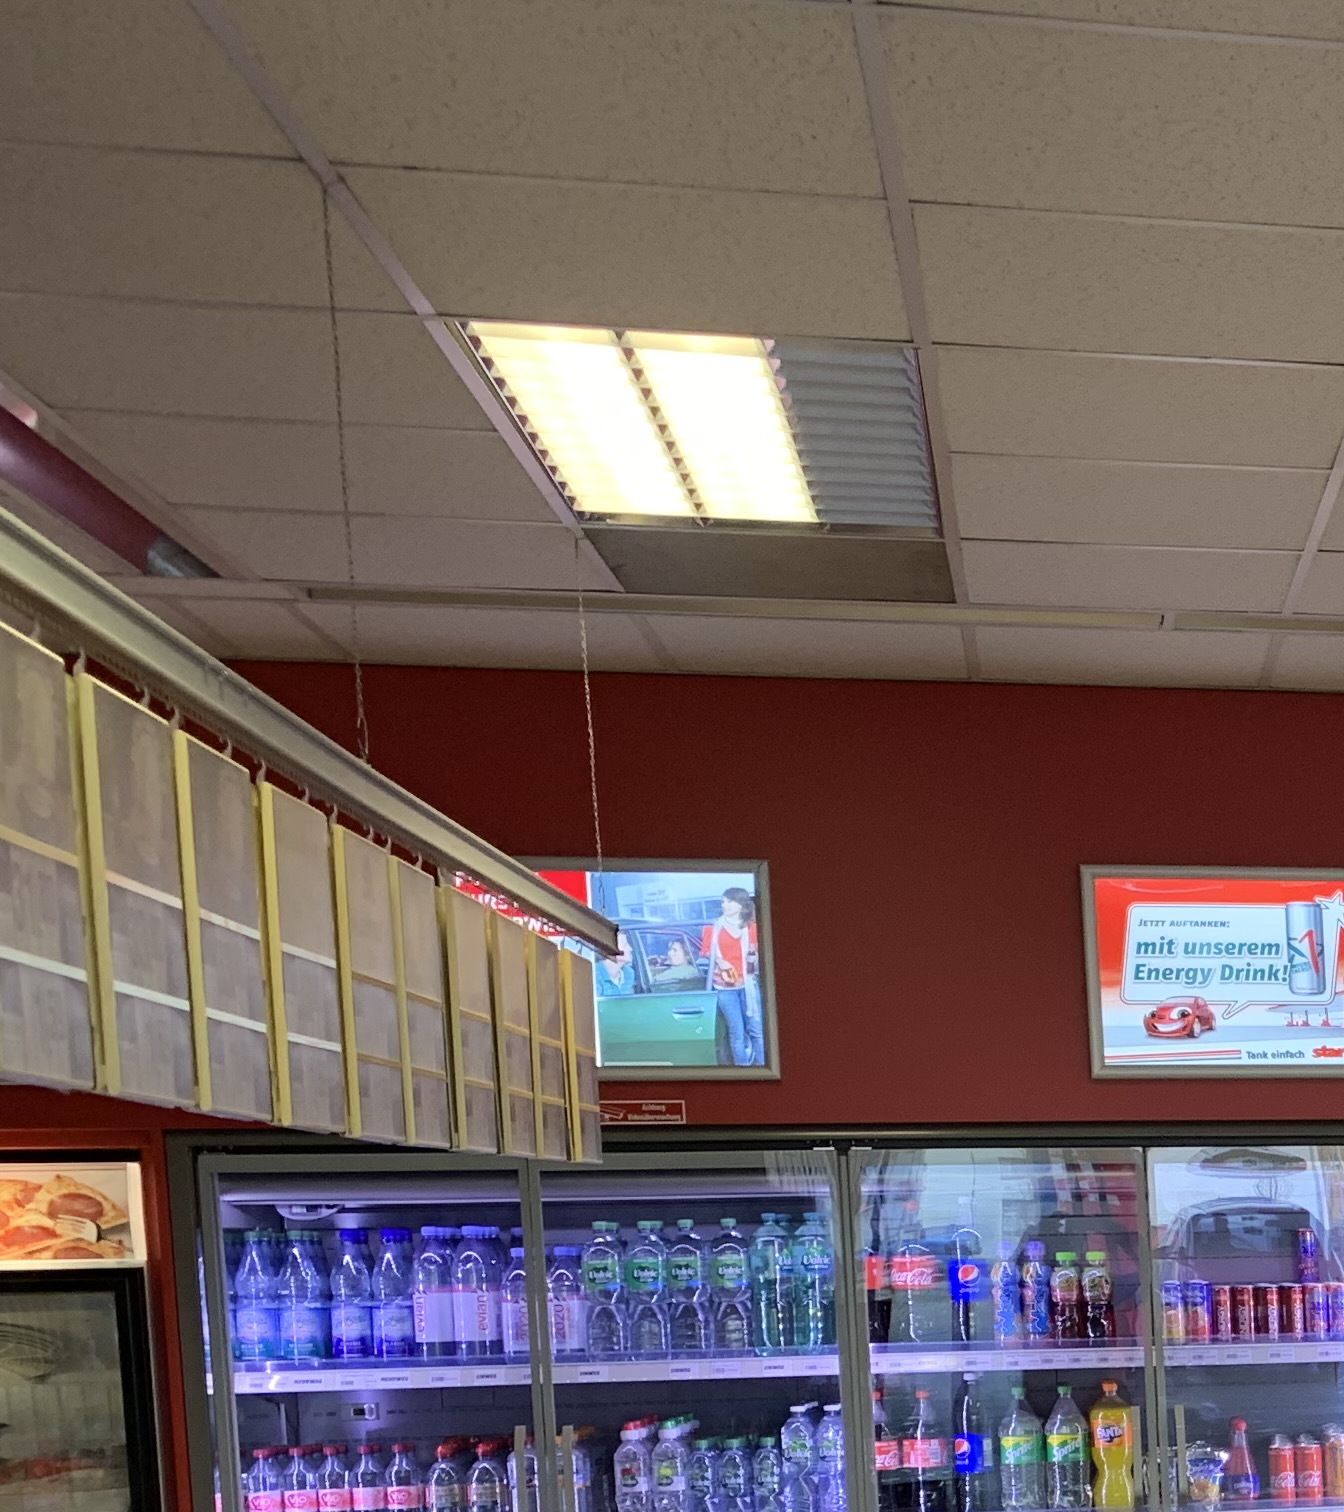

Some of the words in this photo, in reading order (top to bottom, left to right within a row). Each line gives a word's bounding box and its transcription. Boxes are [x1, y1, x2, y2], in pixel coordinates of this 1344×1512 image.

[1135, 935, 1177, 956] mit
[1183, 939, 1281, 957] unserem
[1133, 962, 1213, 986] Energy
[1219, 963, 1289, 984] Drink!
[1246, 1050, 1269, 1060] Tank
[1271, 1049, 1305, 1060] einfach
[478, 1294, 490, 1332] evian
